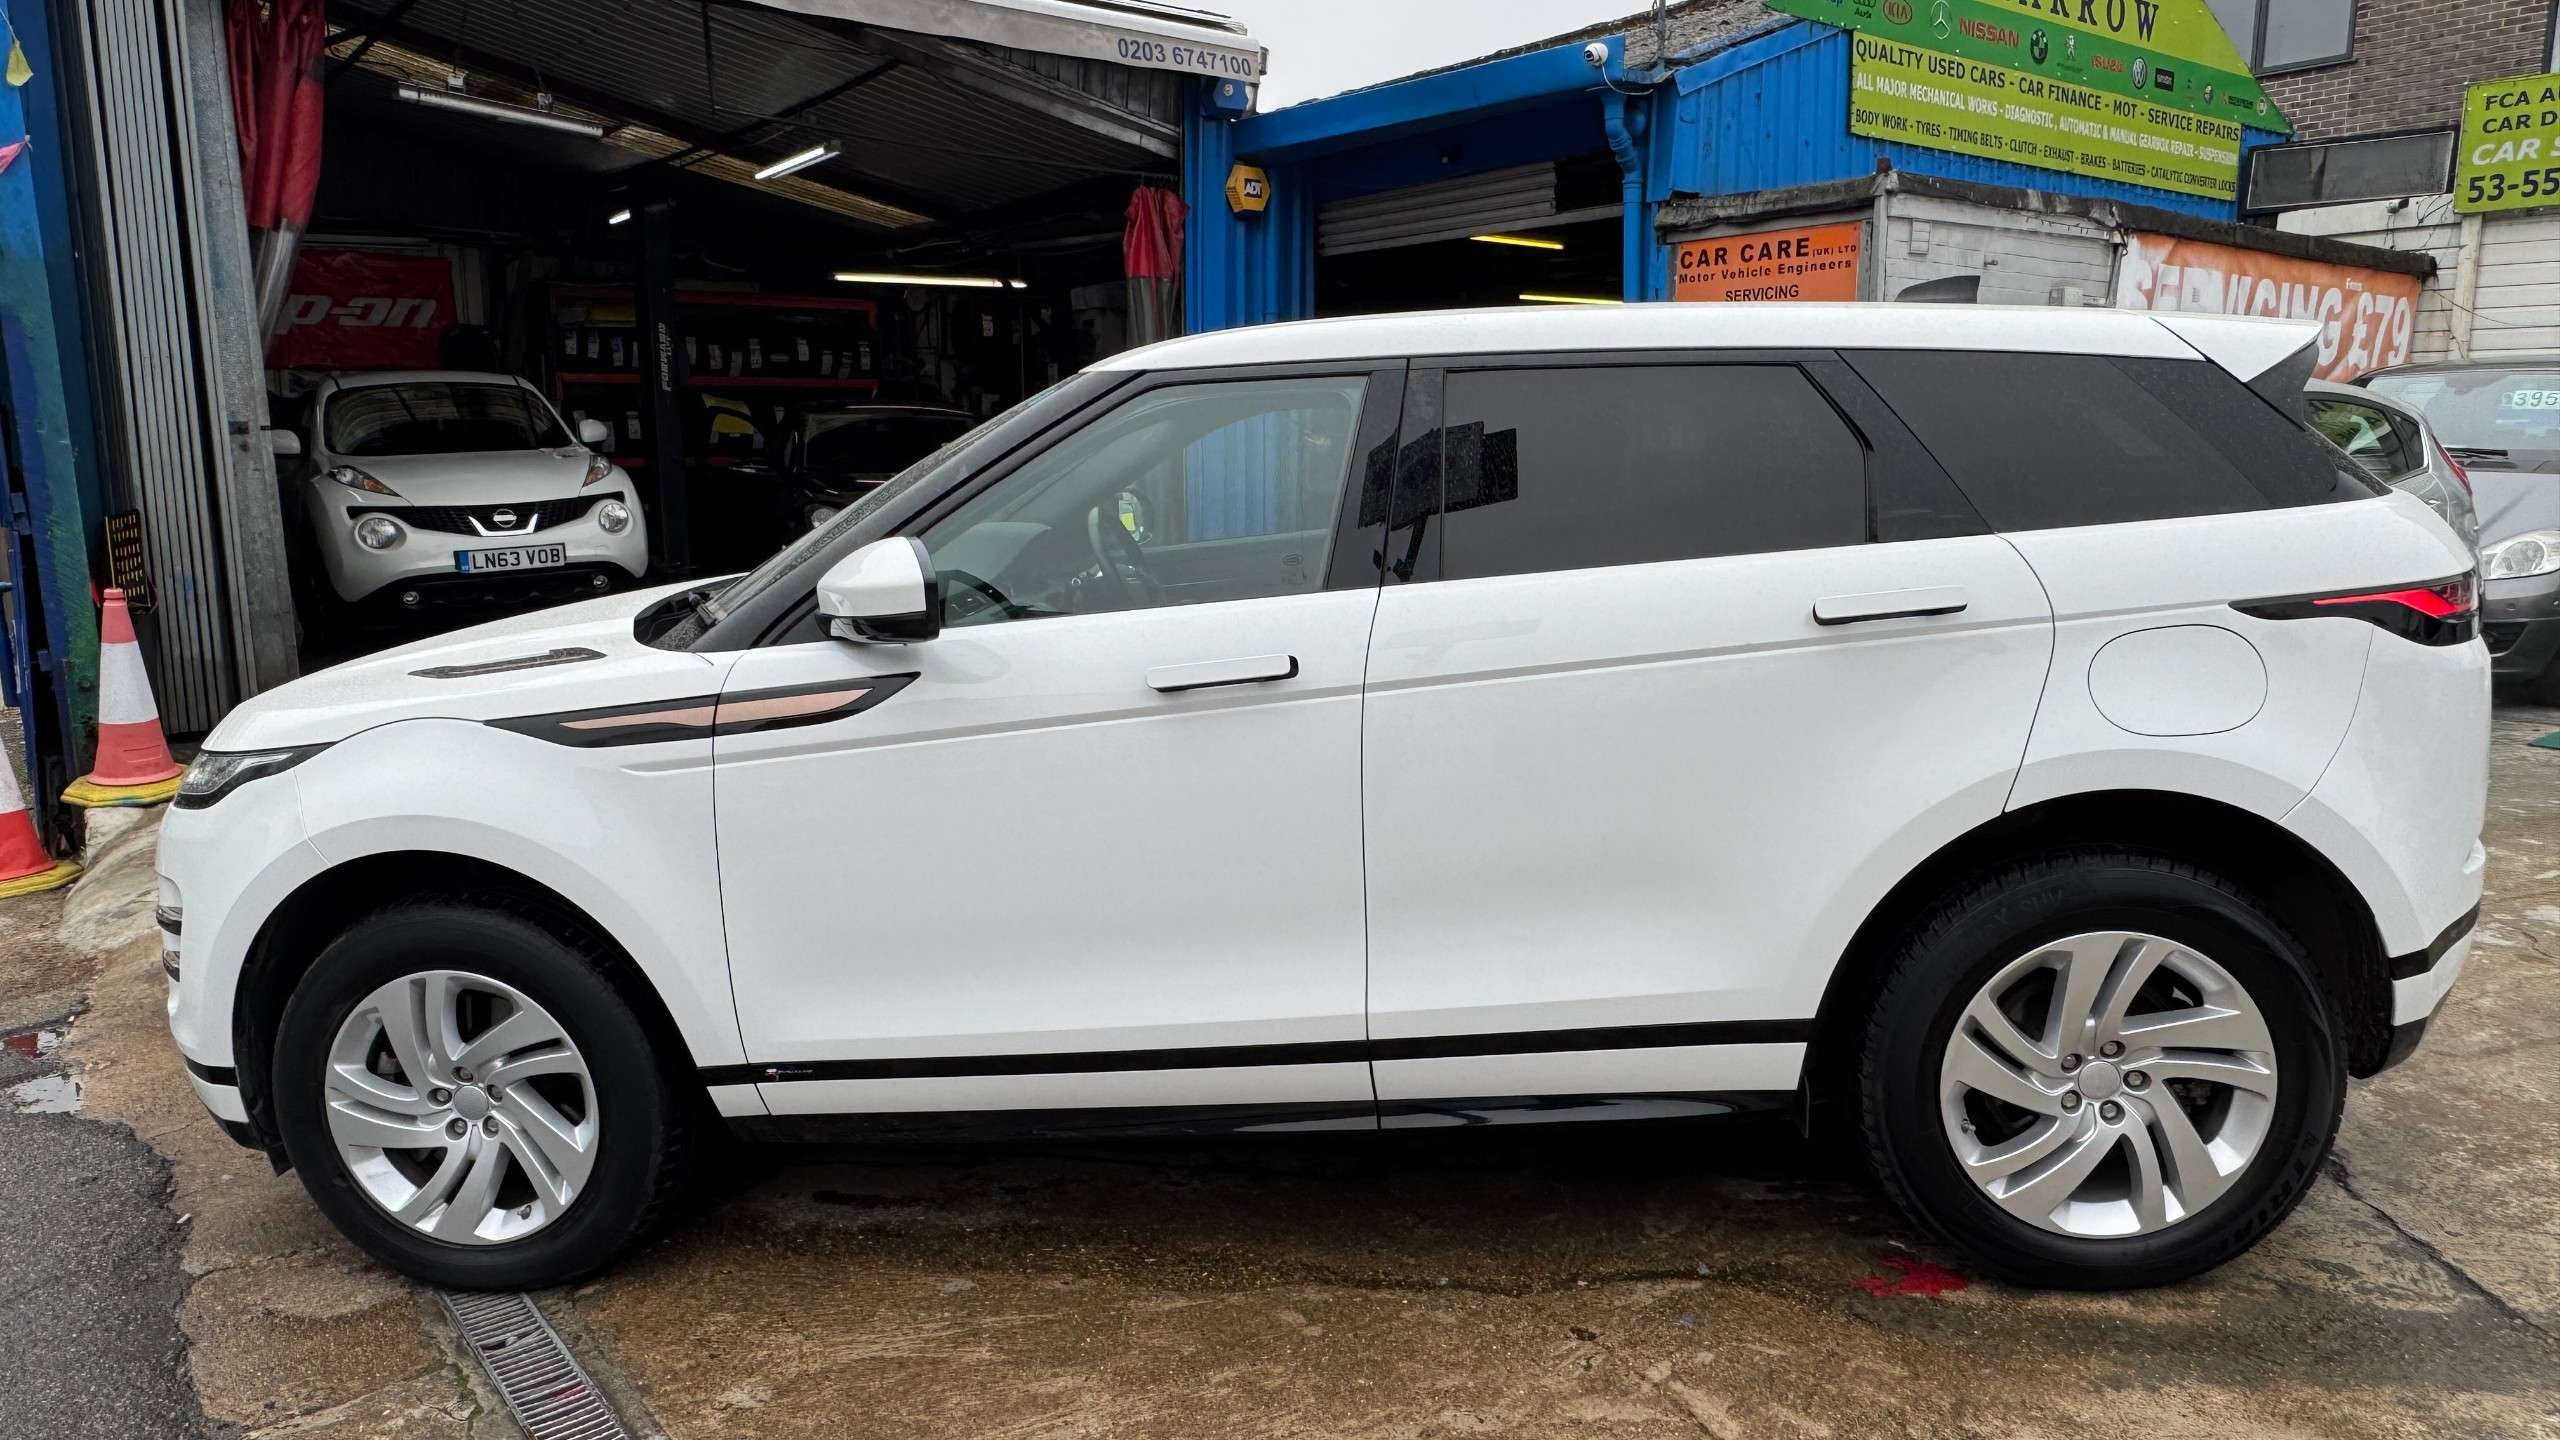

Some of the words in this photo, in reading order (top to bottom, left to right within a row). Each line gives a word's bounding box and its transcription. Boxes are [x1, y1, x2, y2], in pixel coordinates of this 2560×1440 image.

[1959, 16, 2020, 49] NISSAN
[1118, 38, 1166, 63] 0203
[1172, 46, 1252, 77] 6747100
[1856, 38, 1925, 70] QUALITY
[1928, 54, 1966, 79] USED
[1970, 65, 2006, 88] CARS
[2019, 77, 2044, 97] CAR
[2048, 84, 2102, 111] FINANCE
[2113, 99, 2138, 119] MOT
[2147, 108, 2193, 132] SERVICE
[2196, 119, 2240, 141] REPAIRS
[1856, 72, 1874, 91] ALL
[1876, 76, 1907, 98] MAJOR
[1909, 83, 1965, 111] MECHANICAL
[1967, 96, 1998, 117] WORKS
[2485, 90, 2531, 111] FCA
[2482, 114, 2531, 134] CAR
[1856, 108, 1879, 126] BODY
[1882, 114, 1908, 132] WORK
[1916, 120, 1941, 138] TYRES
[1949, 127, 1979, 146] TIMING
[1980, 131, 2003, 149] BELTS
[2009, 138, 2037, 156] CLUTCH
[2044, 145, 2075, 163] EXHAUST
[2080, 152, 2106, 168] BRAKES
[2151, 166, 2183, 183] CATALYTIC
[2184, 173, 2217, 190] CONVERTER
[2472, 138, 2541, 165] CAR
[1680, 247, 1728, 270] CAR
[1740, 237, 1810, 264] CARE
[1838, 244, 1857, 254] LTD
[1679, 272, 1716, 284] Motor
[1721, 266, 1771, 279] Vehicle
[1778, 260, 1852, 276] Engineers
[1725, 284, 1800, 302] SERVICING
[2347, 290, 2412, 370] £79
[472, 551, 521, 570] LN63
[526, 548, 561, 565] VOB
